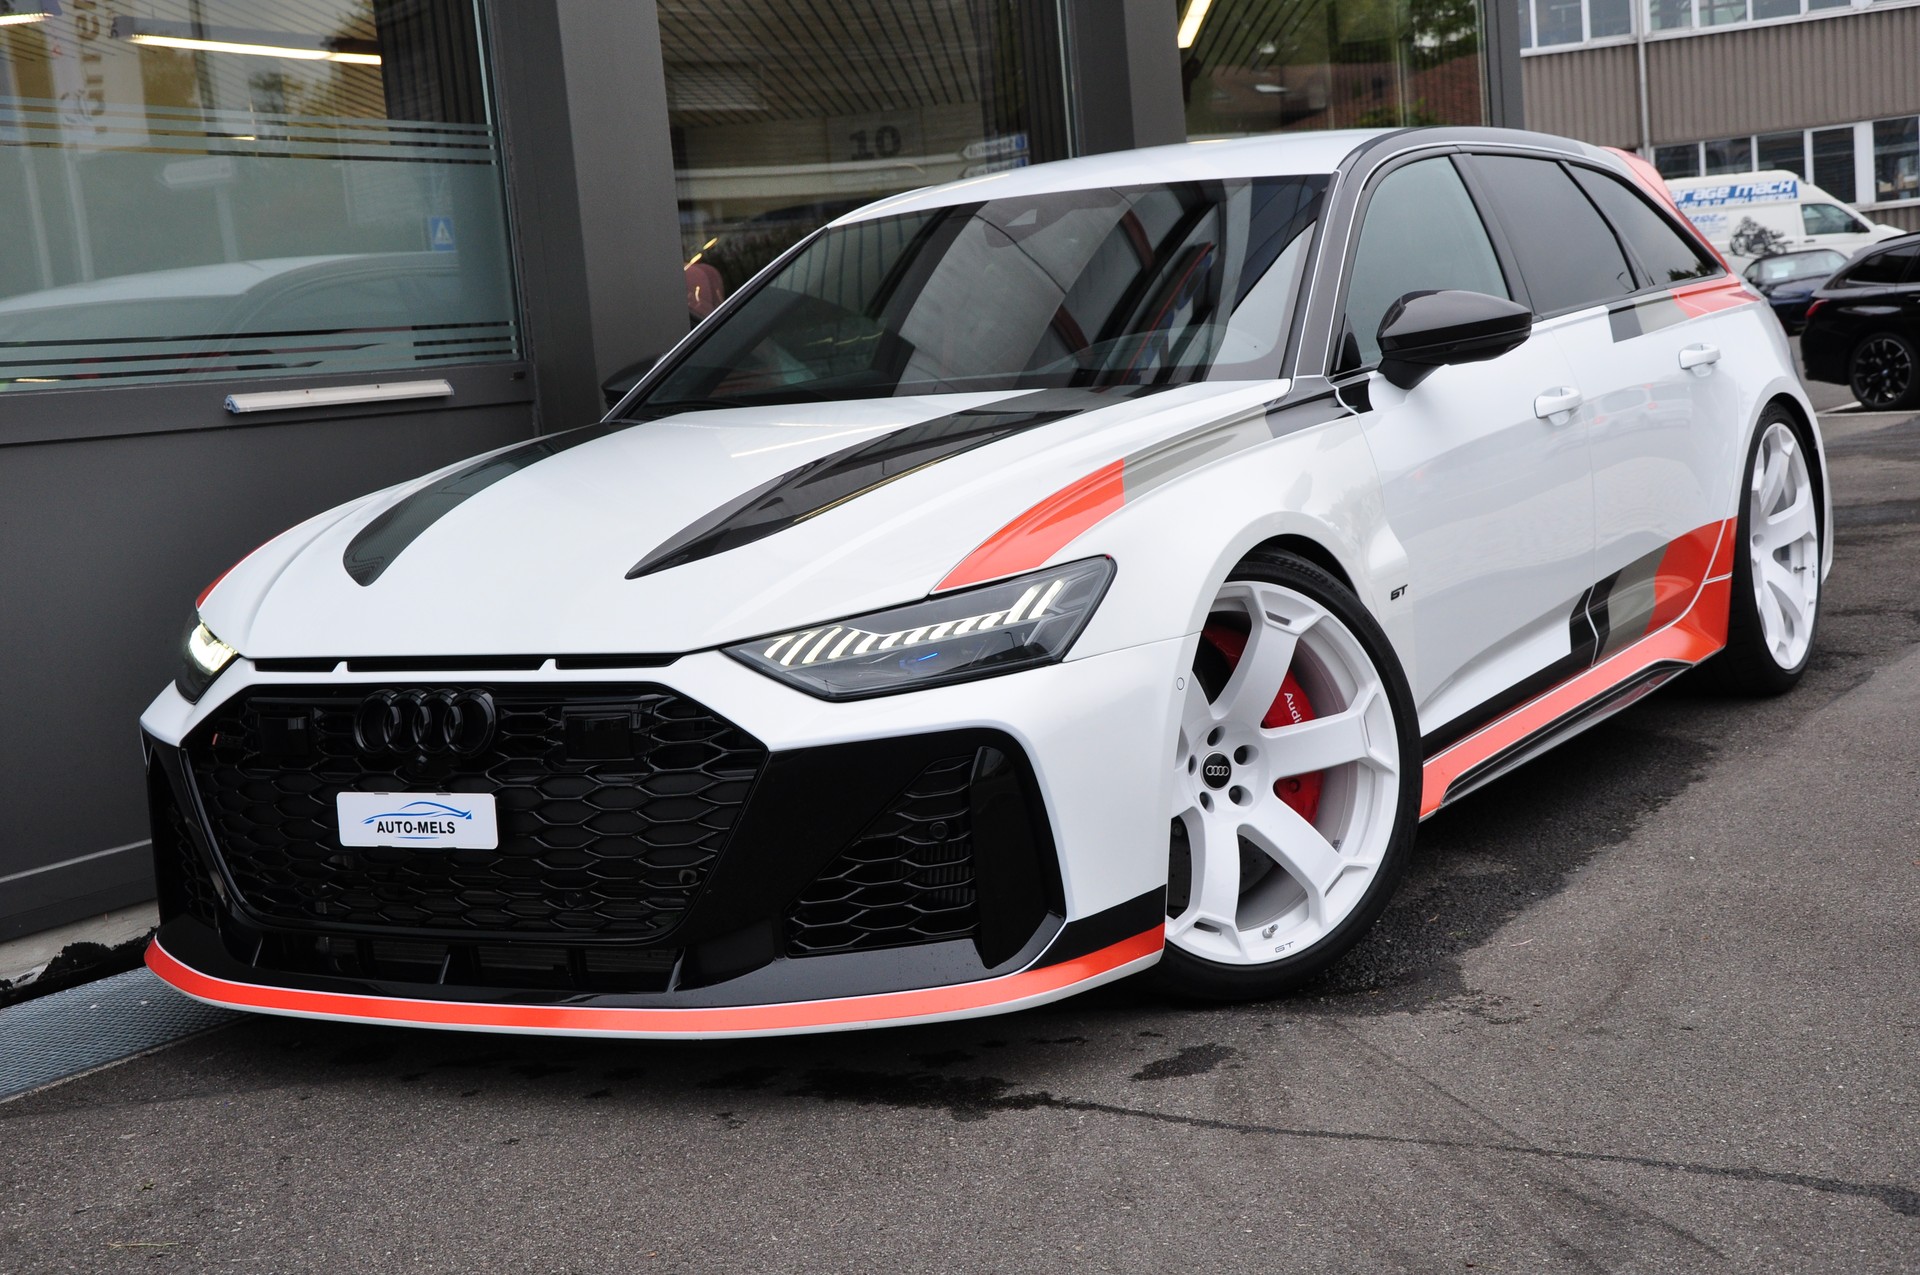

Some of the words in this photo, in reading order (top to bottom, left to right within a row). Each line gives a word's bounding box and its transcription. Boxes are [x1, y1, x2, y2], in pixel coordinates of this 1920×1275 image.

[850, 125, 901, 160] 10
[1391, 584, 1408, 601] GT
[1284, 692, 1302, 724] Audi
[376, 821, 456, 835] AUTO-MELS
[1275, 940, 1294, 953] GT
